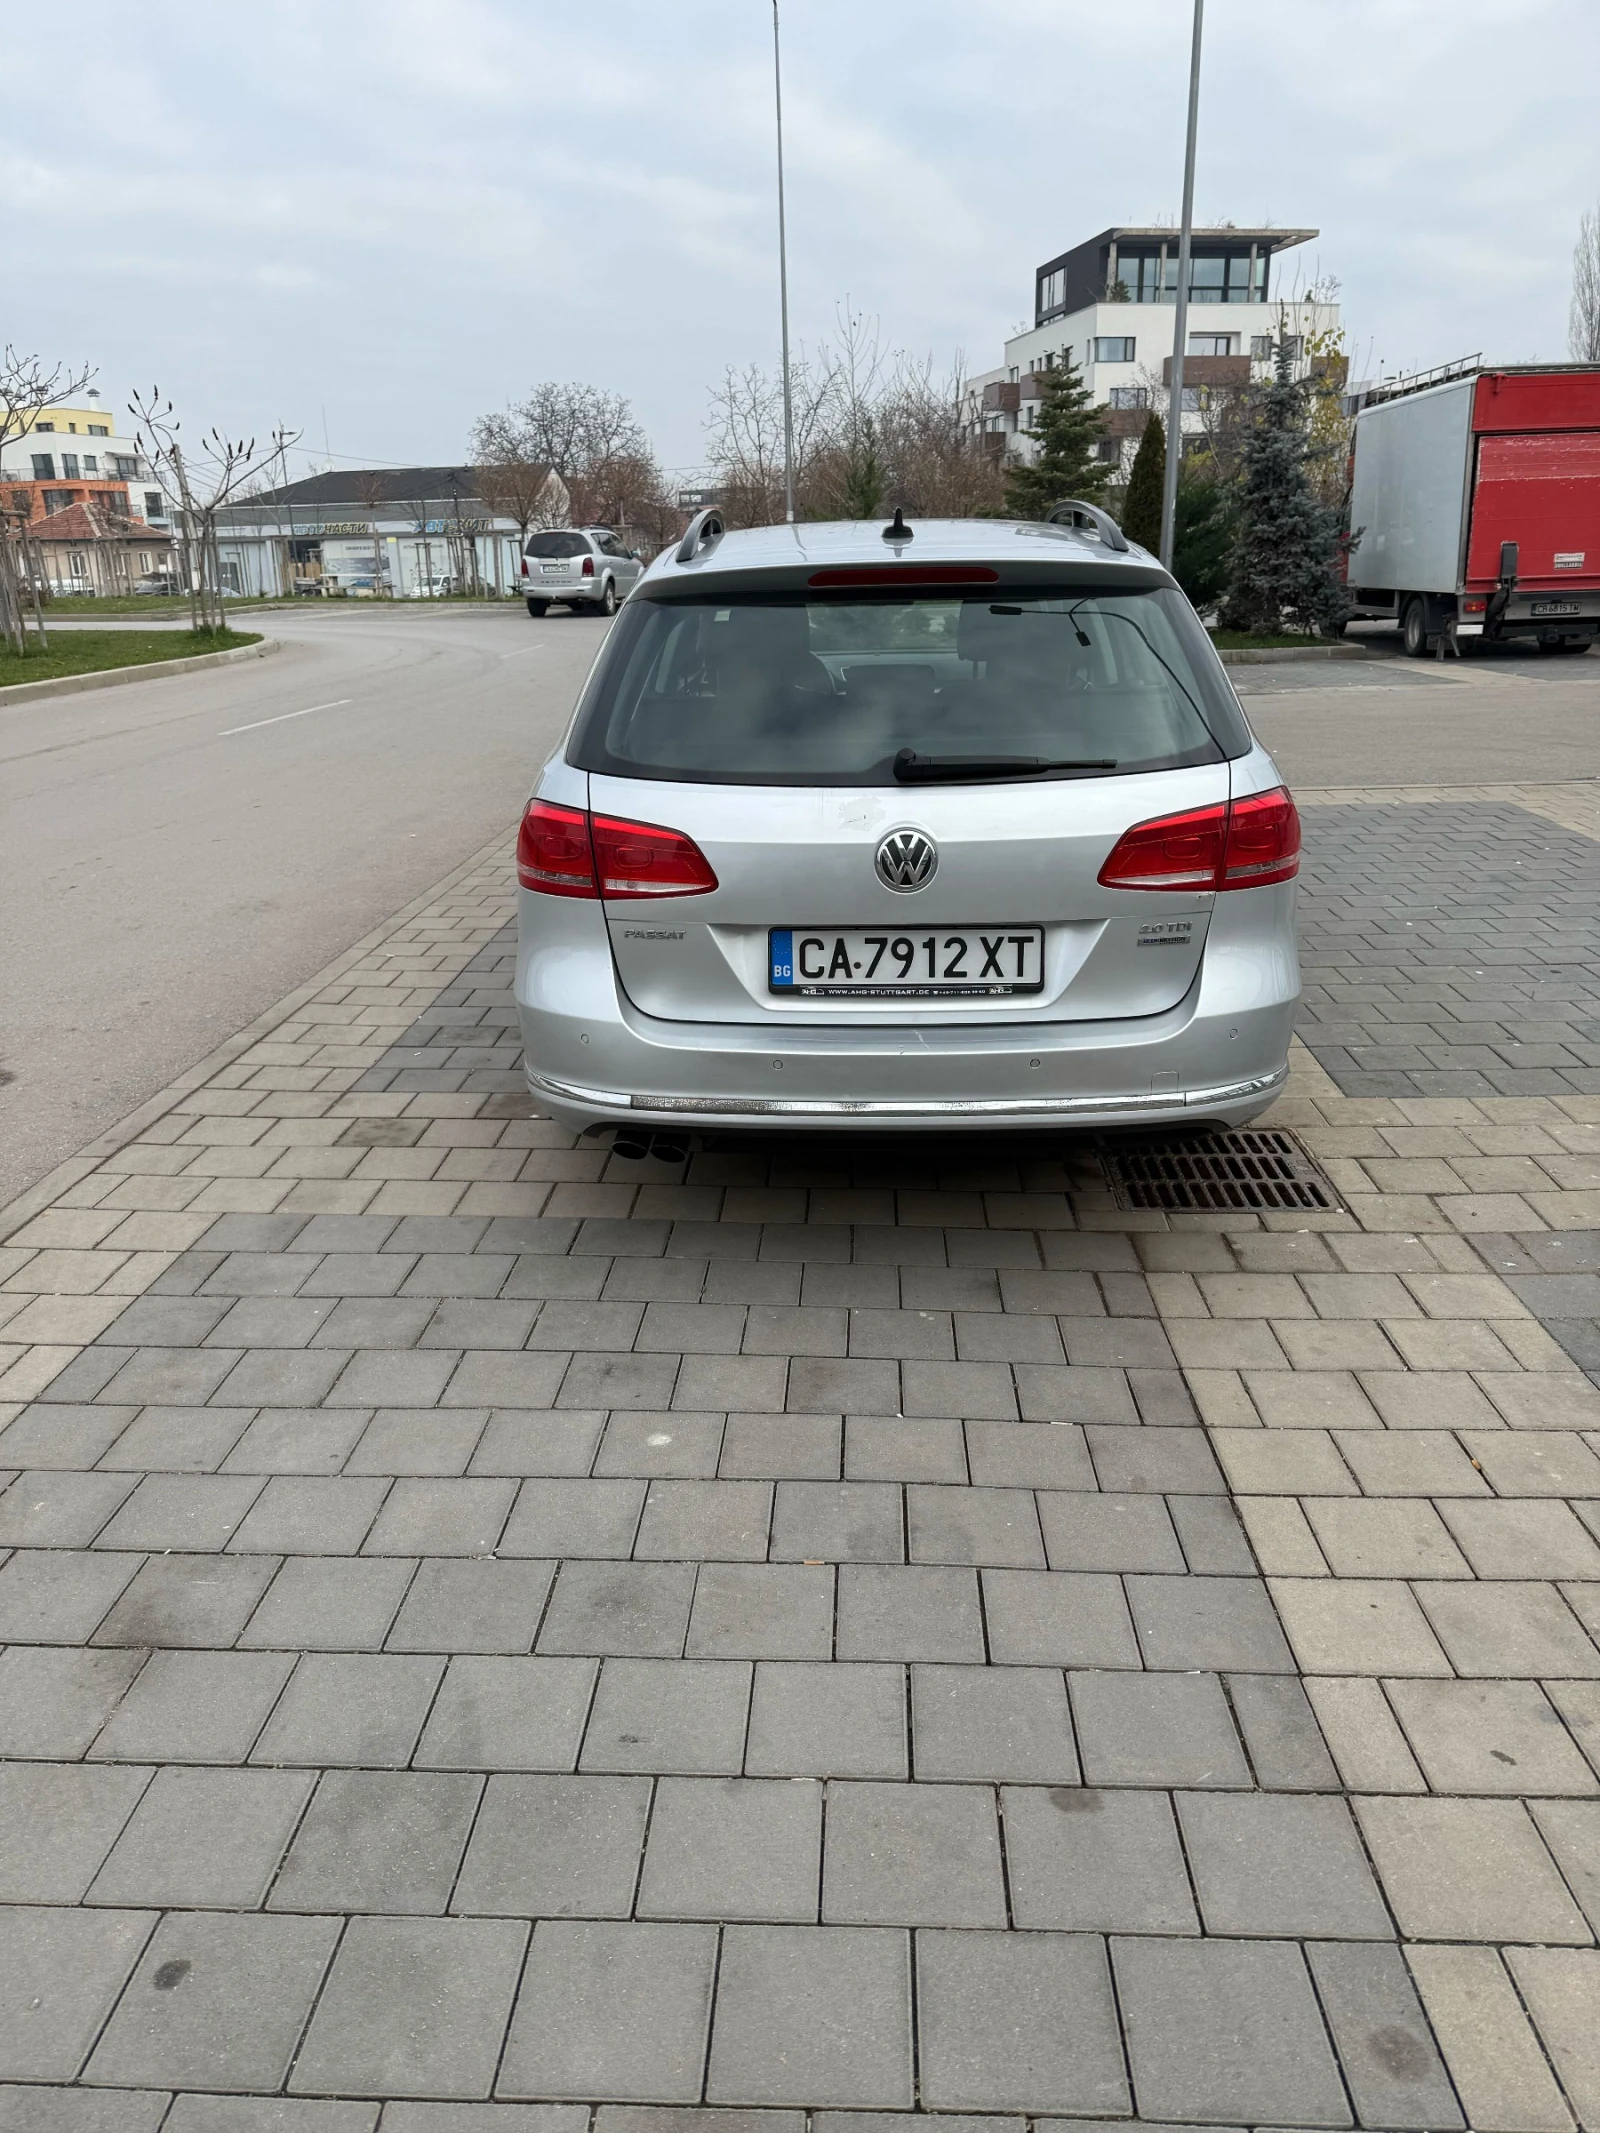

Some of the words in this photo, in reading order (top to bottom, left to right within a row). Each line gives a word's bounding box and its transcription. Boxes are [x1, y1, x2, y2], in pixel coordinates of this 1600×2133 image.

[1166, 921, 1193, 933] TDI
[624, 928, 687, 940] PASSAT
[774, 965, 791, 978] BG
